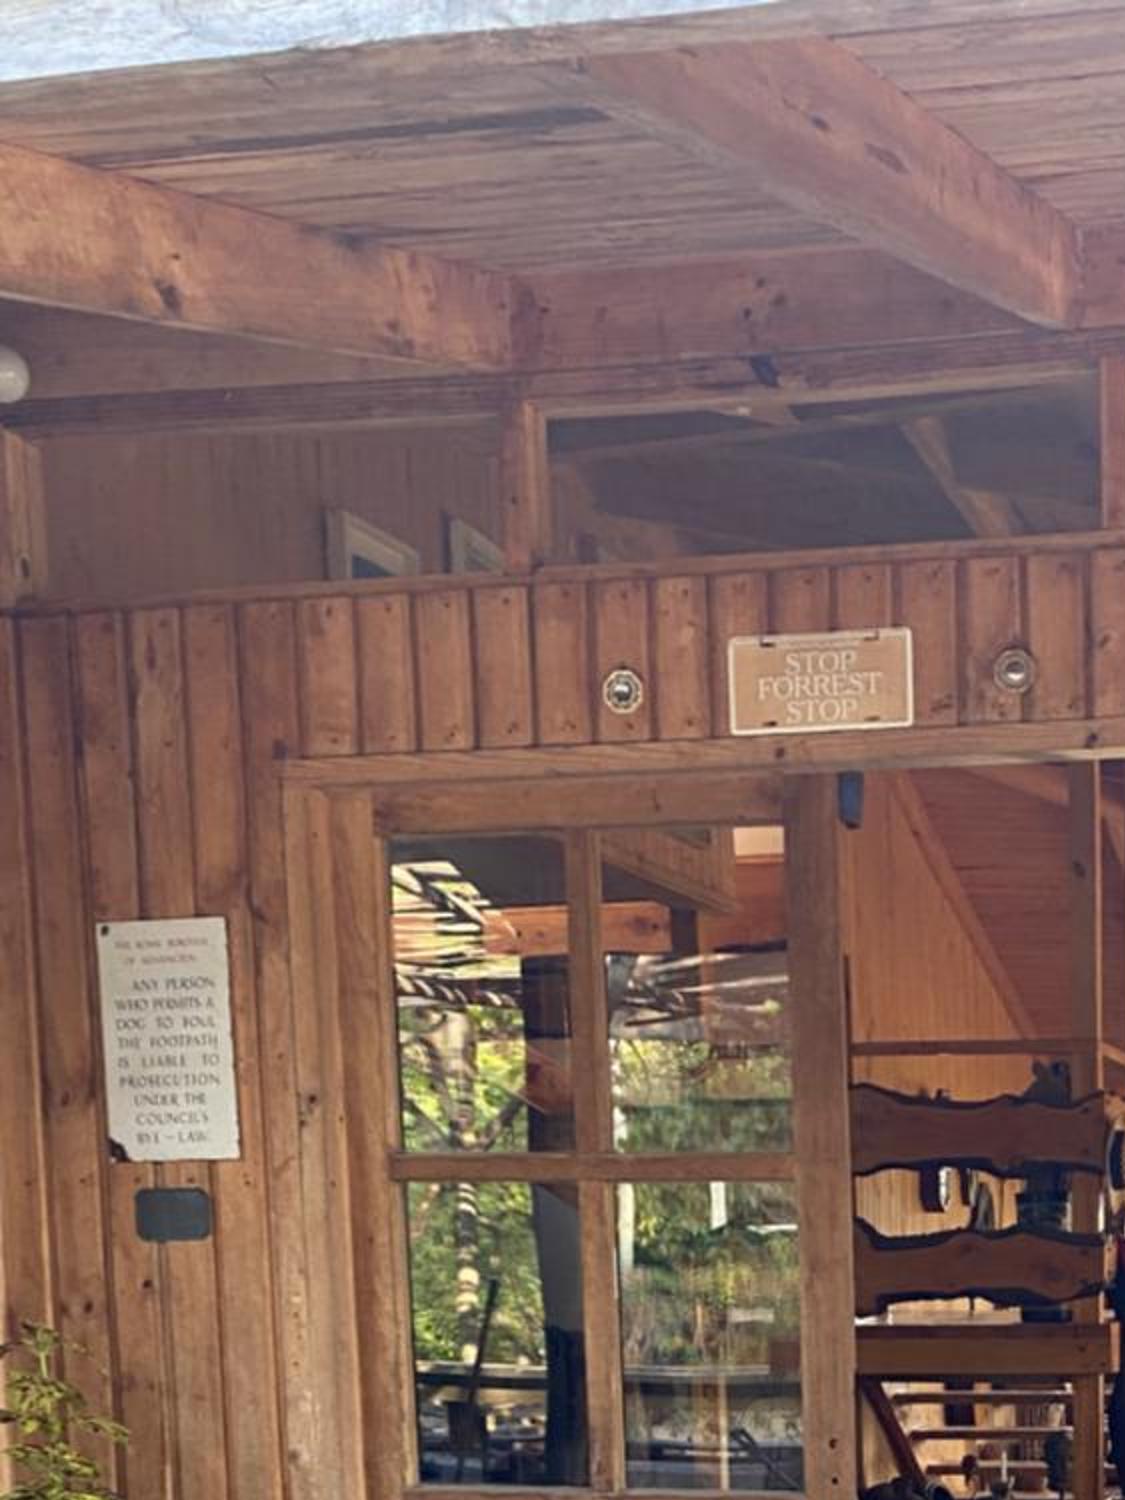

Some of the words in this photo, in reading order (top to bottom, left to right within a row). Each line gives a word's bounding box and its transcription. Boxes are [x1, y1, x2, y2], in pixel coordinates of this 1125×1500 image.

[784, 650, 857, 674] STOP
[758, 671, 883, 701] FORREST
[785, 697, 857, 722] STOP
[132, 979, 159, 991] ANY
[165, 976, 215, 991] PERSON
[114, 999, 148, 1011] WHO
[115, 1018, 146, 1030] DOG
[156, 1017, 173, 1029] TO
[117, 1038, 140, 1050] THE
[150, 1034, 219, 1049] FOOTPATH
[141, 1055, 186, 1068] LIABLE
[202, 1053, 220, 1066] TO
[119, 1073, 221, 1088] PROSECUTION
[134, 1094, 178, 1106] UNDER
[185, 1092, 206, 1104] THE
